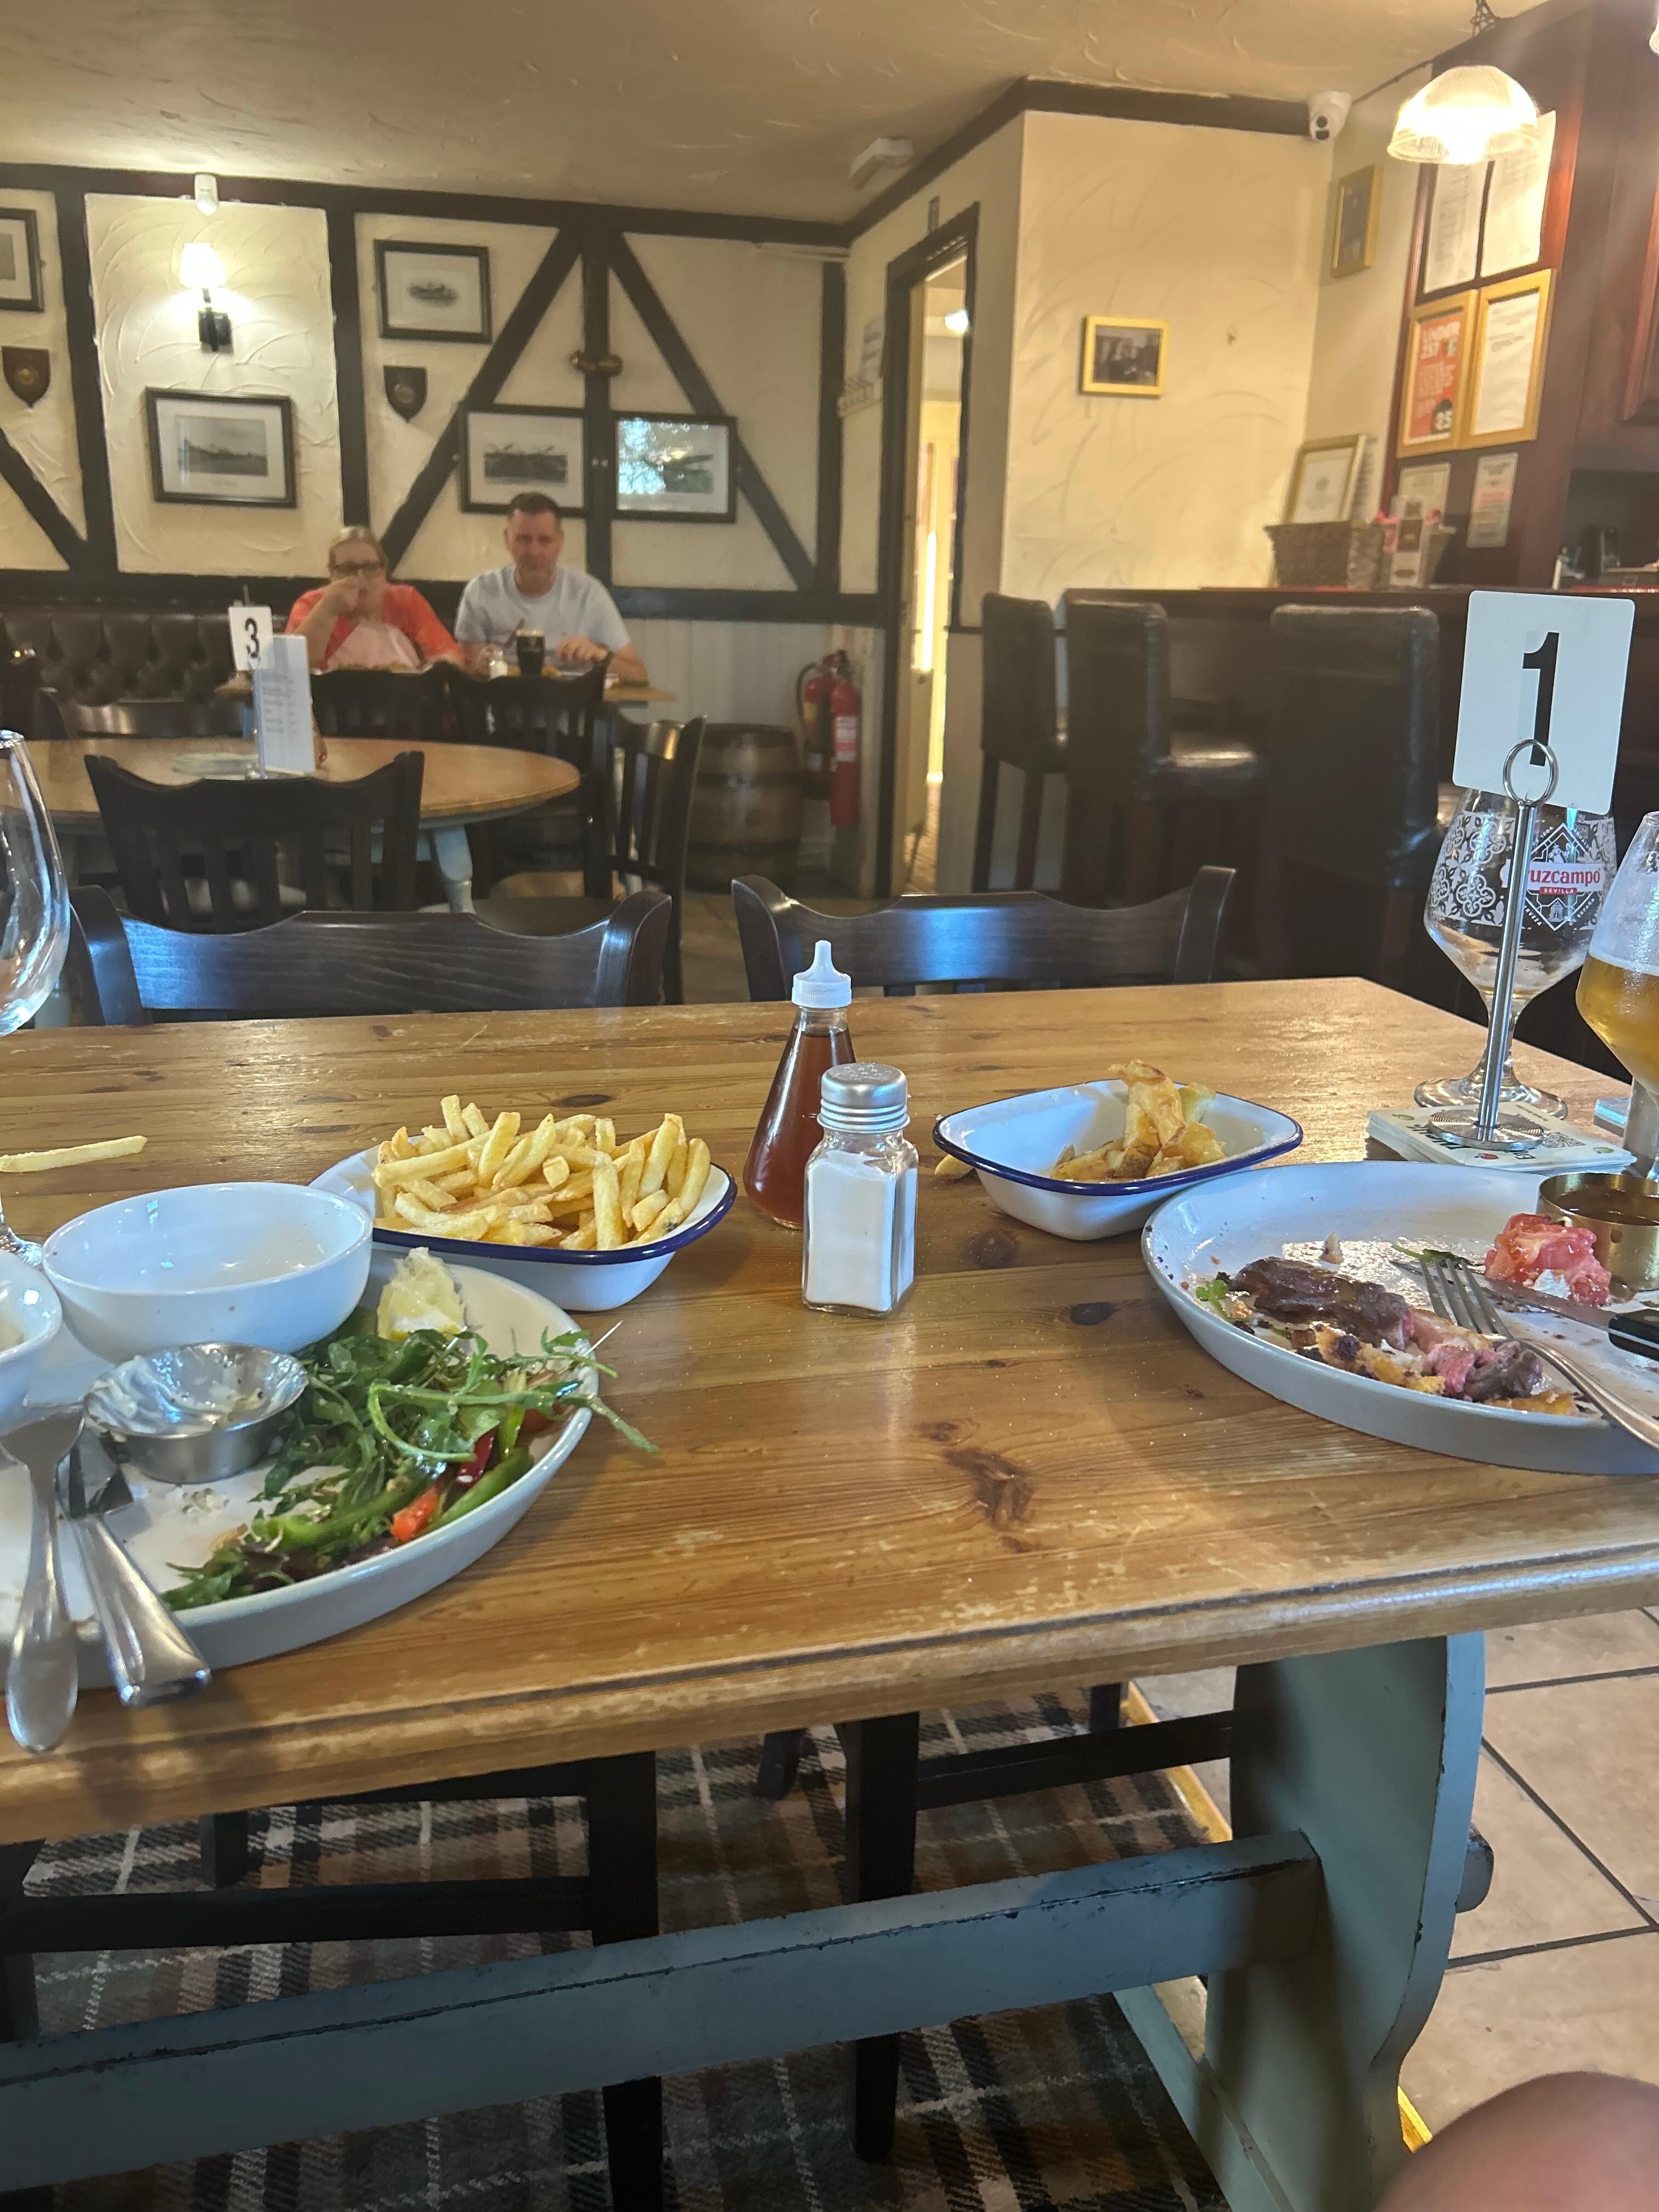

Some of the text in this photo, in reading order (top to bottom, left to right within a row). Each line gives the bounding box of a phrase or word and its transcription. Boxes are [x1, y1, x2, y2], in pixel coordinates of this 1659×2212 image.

[245, 618, 260, 658] 3
[1523, 631, 1560, 766] 1
[1530, 869, 1600, 887] uzcampo
[1524, 906, 1542, 927] ERVEZA
